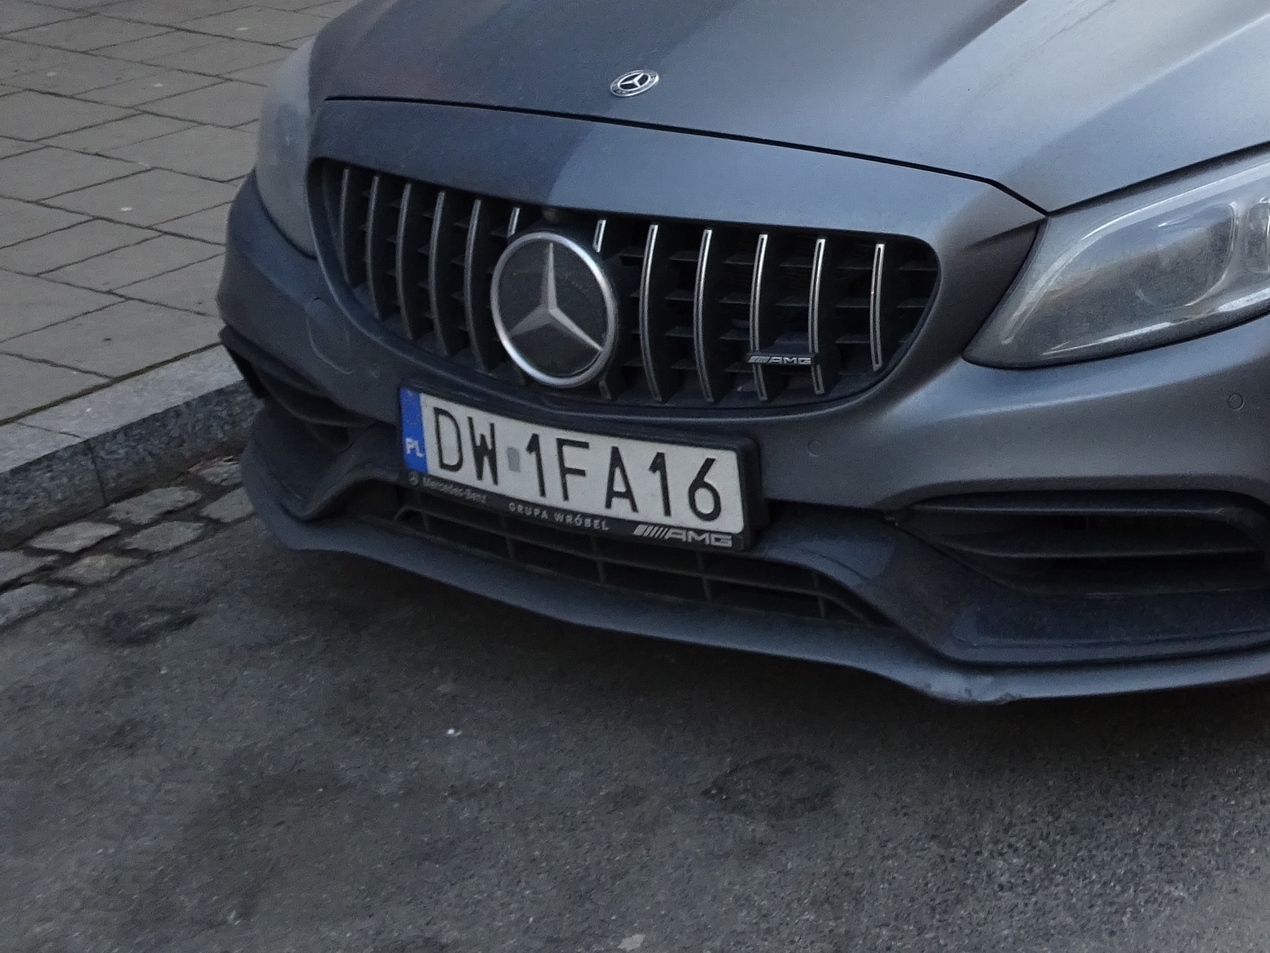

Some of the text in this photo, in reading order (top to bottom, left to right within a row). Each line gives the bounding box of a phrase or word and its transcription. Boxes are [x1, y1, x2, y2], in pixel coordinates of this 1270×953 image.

[404, 438, 425, 458] PL
[434, 407, 722, 522] DW 1FA16
[508, 502, 610, 532] GRUPA WRÓBEL
